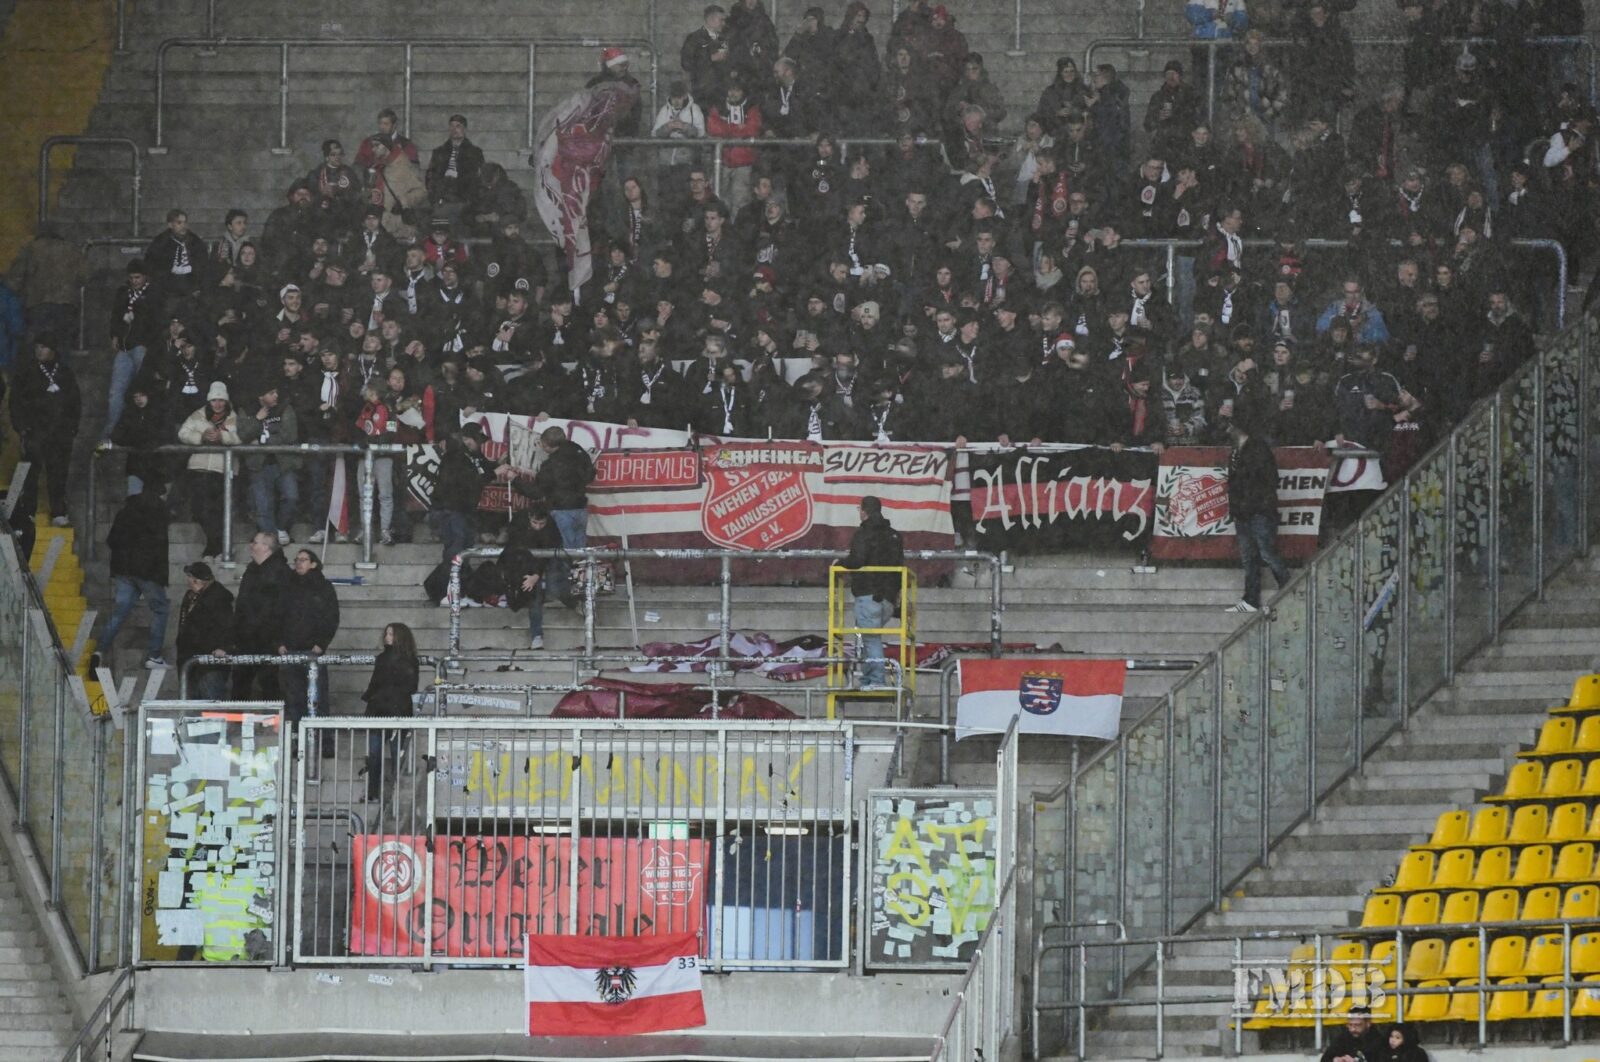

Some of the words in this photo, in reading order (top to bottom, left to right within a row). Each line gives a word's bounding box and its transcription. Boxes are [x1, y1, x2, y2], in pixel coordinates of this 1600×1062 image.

[595, 456, 695, 481] SUPREMUS
[824, 450, 949, 476] SUPCREW
[1278, 475, 1326, 490] HEN
[711, 482, 760, 519] WEHEN
[721, 484, 802, 538] TAUNUSSTEIN
[973, 456, 1152, 541] Allianz
[761, 521, 784, 542] e.V.
[678, 956, 696, 969] 33
